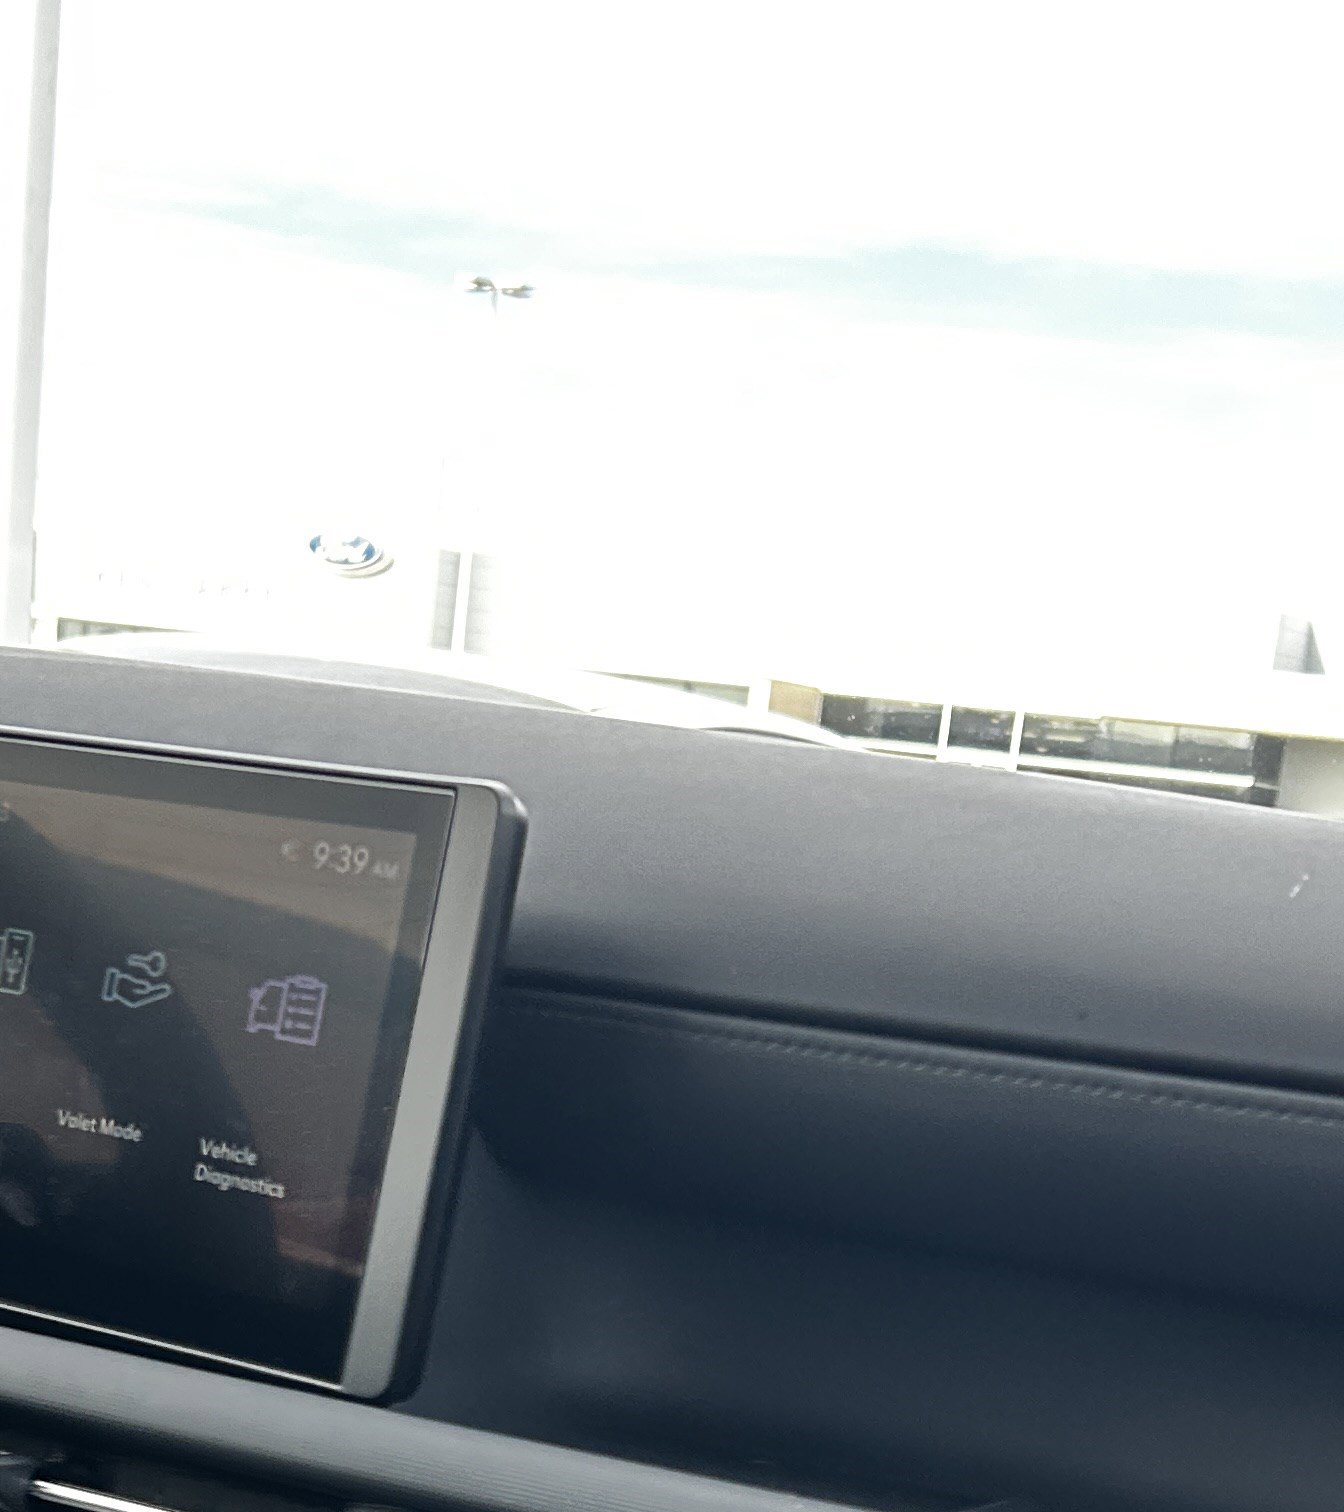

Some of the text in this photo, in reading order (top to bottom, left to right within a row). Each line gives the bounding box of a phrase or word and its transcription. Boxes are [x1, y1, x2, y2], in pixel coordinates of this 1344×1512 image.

[314, 841, 369, 874] 9:39
[56, 1108, 144, 1142] Valet Mode
[199, 1136, 257, 1166] Vehicle
[194, 1162, 286, 1199] Diagnostics
